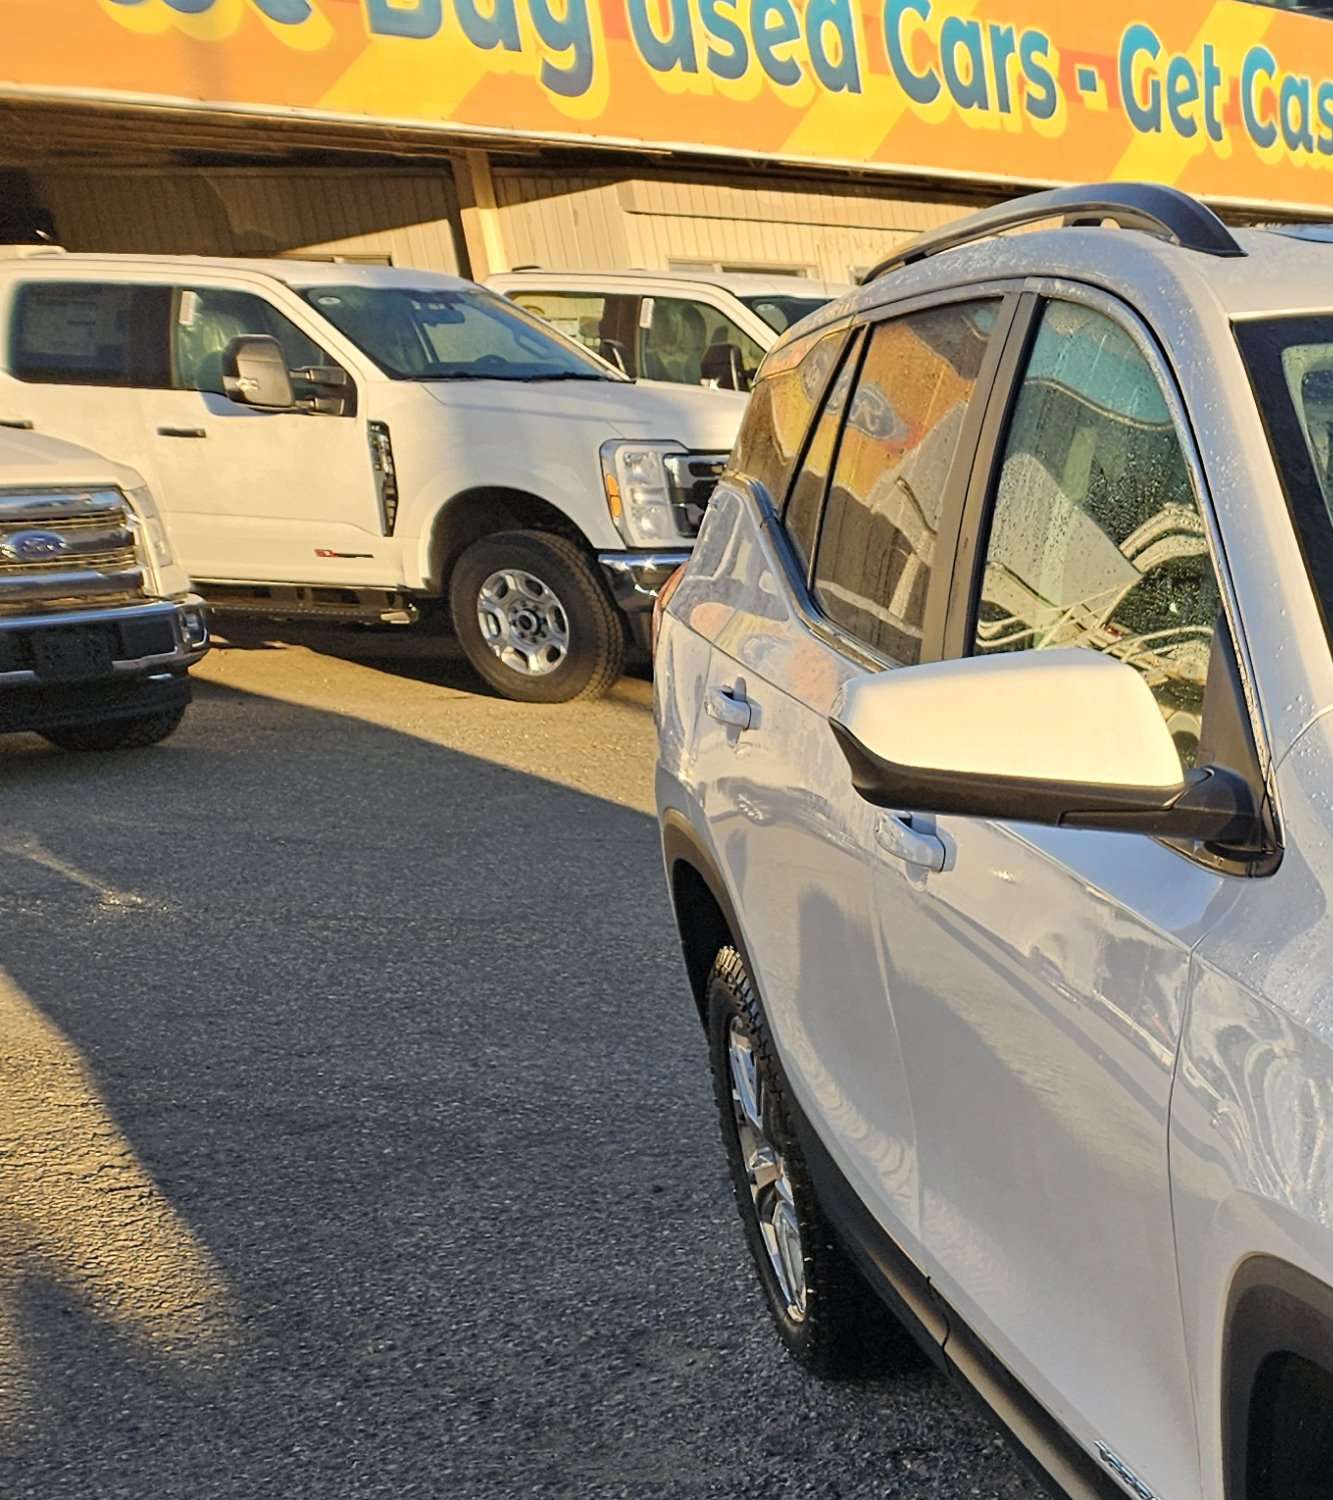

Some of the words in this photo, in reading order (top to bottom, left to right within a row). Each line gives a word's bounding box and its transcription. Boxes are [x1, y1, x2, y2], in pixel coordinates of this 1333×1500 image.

[368, 0, 595, 98] uy
[629, 0, 862, 94] used
[884, 0, 1057, 120] Cars
[1120, 24, 1223, 142] Get
